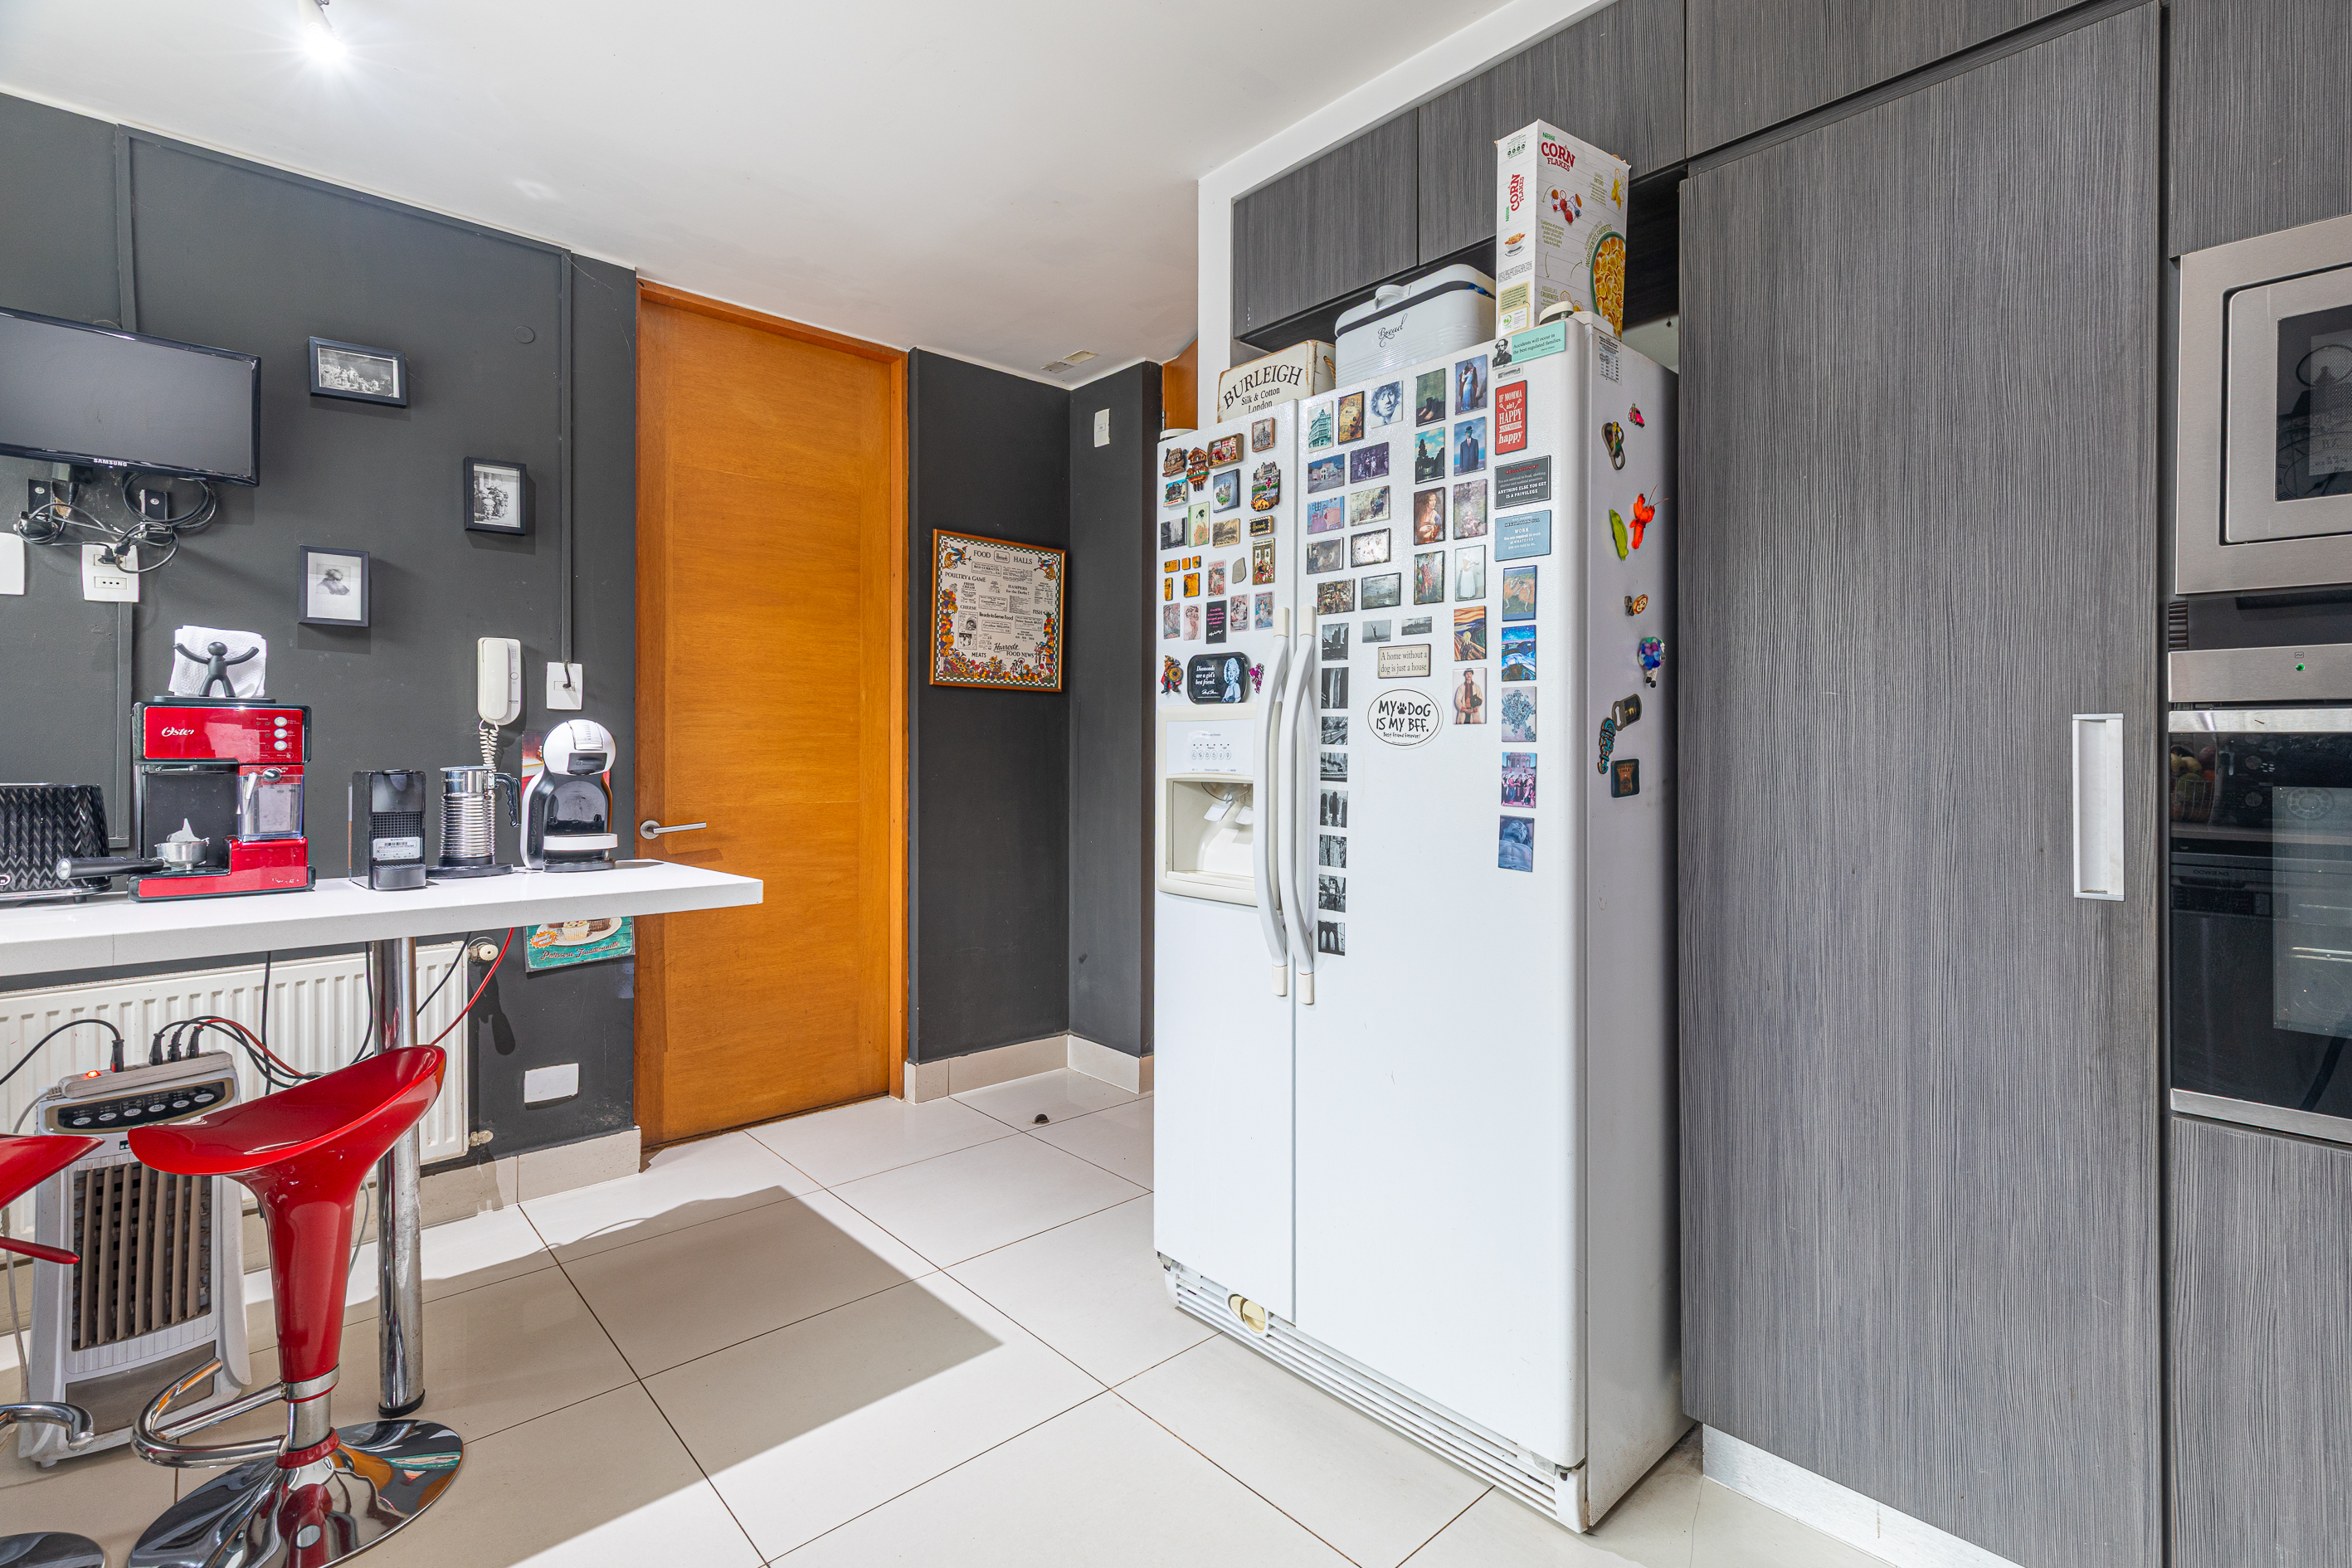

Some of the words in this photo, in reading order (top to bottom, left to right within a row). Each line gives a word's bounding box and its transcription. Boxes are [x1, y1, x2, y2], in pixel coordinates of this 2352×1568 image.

[1541, 142, 1575, 168] CORN
[1547, 158, 1570, 172] FLAKES
[1510, 174, 1521, 211] CORN
[1377, 313, 1409, 348] Bread
[1527, 342, 1545, 351] regulated
[1223, 365, 1303, 410] BURLEIGH
[1241, 395, 1252, 406] Silk
[1254, 393, 1259, 402] &
[1261, 387, 1280, 399] Cotton
[1499, 394, 1504, 403] IF
[1505, 390, 1522, 402] MOMMA
[1248, 400, 1273, 413] London
[1499, 408, 1522, 425] HAPPY
[1498, 431, 1523, 445] happy
[93, 458, 128, 466] SAMSUNG
[1506, 466, 1531, 475] REGULATION
[1498, 486, 1518, 494] ANYTHING
[1515, 489, 1538, 497] PRIVILEGE
[1014, 556, 1032, 564] HALLS
[945, 572, 967, 580] POULTRY
[1381, 652, 1385, 660] A
[1402, 650, 1423, 659] without
[1381, 665, 1390, 674] dog
[1396, 664, 1406, 674] just
[1379, 700, 1397, 717] MY
[1408, 702, 1431, 717] DOG
[1376, 718, 1386, 730] IS
[1389, 717, 1405, 732] MY
[161, 727, 194, 737] Oster
[576, 941, 619, 958] Traditionnelle
